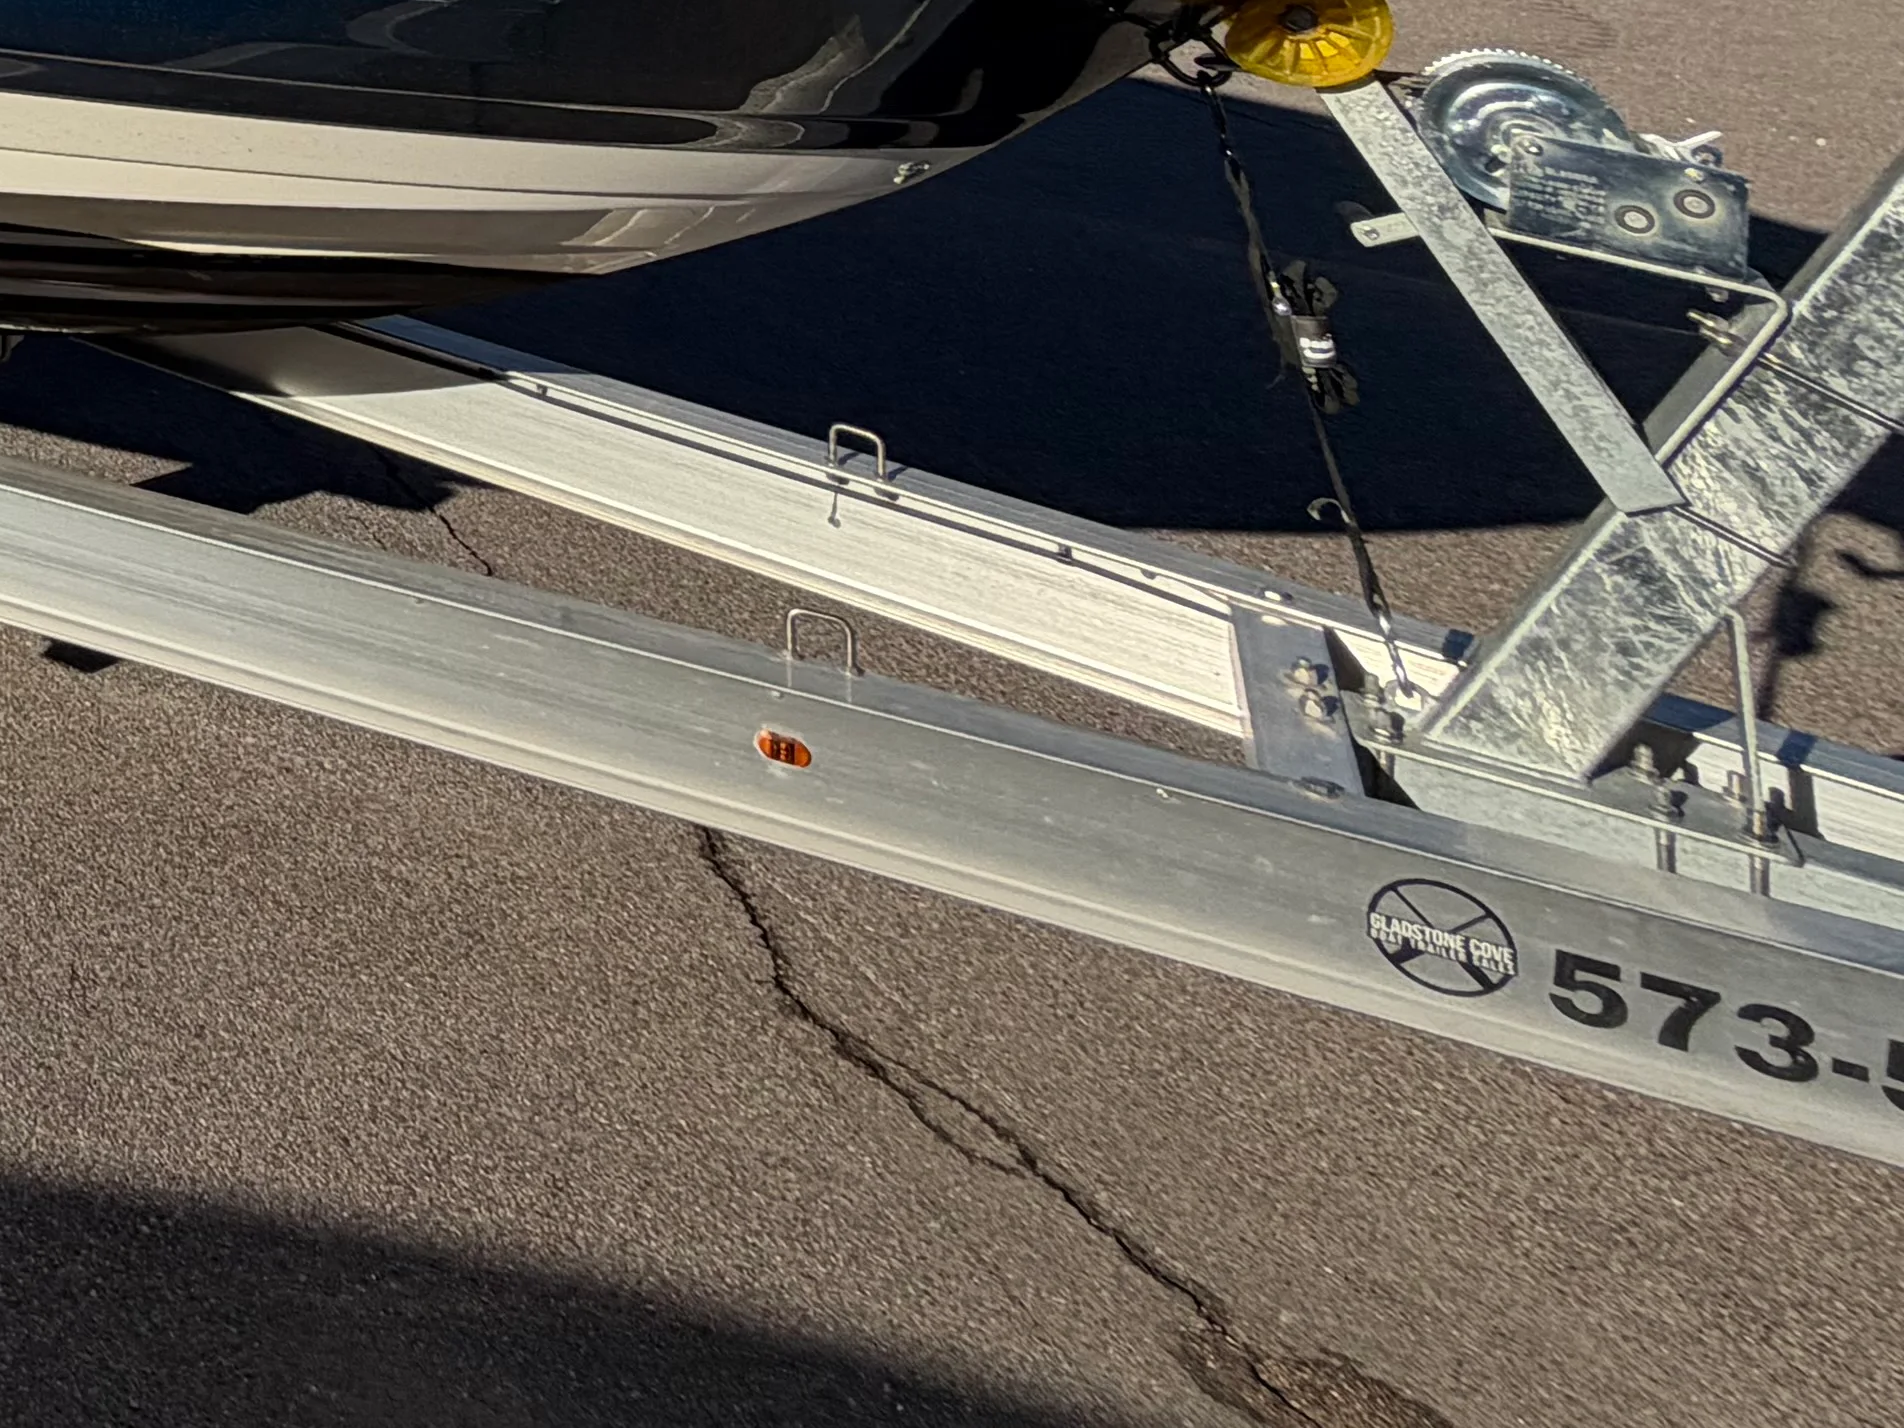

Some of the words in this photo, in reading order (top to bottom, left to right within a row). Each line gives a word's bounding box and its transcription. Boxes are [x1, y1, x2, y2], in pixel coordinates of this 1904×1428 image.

[1369, 911, 1466, 952] GLADSTONE
[1469, 938, 1515, 965] COVE
[1548, 948, 1904, 1112] 573-
